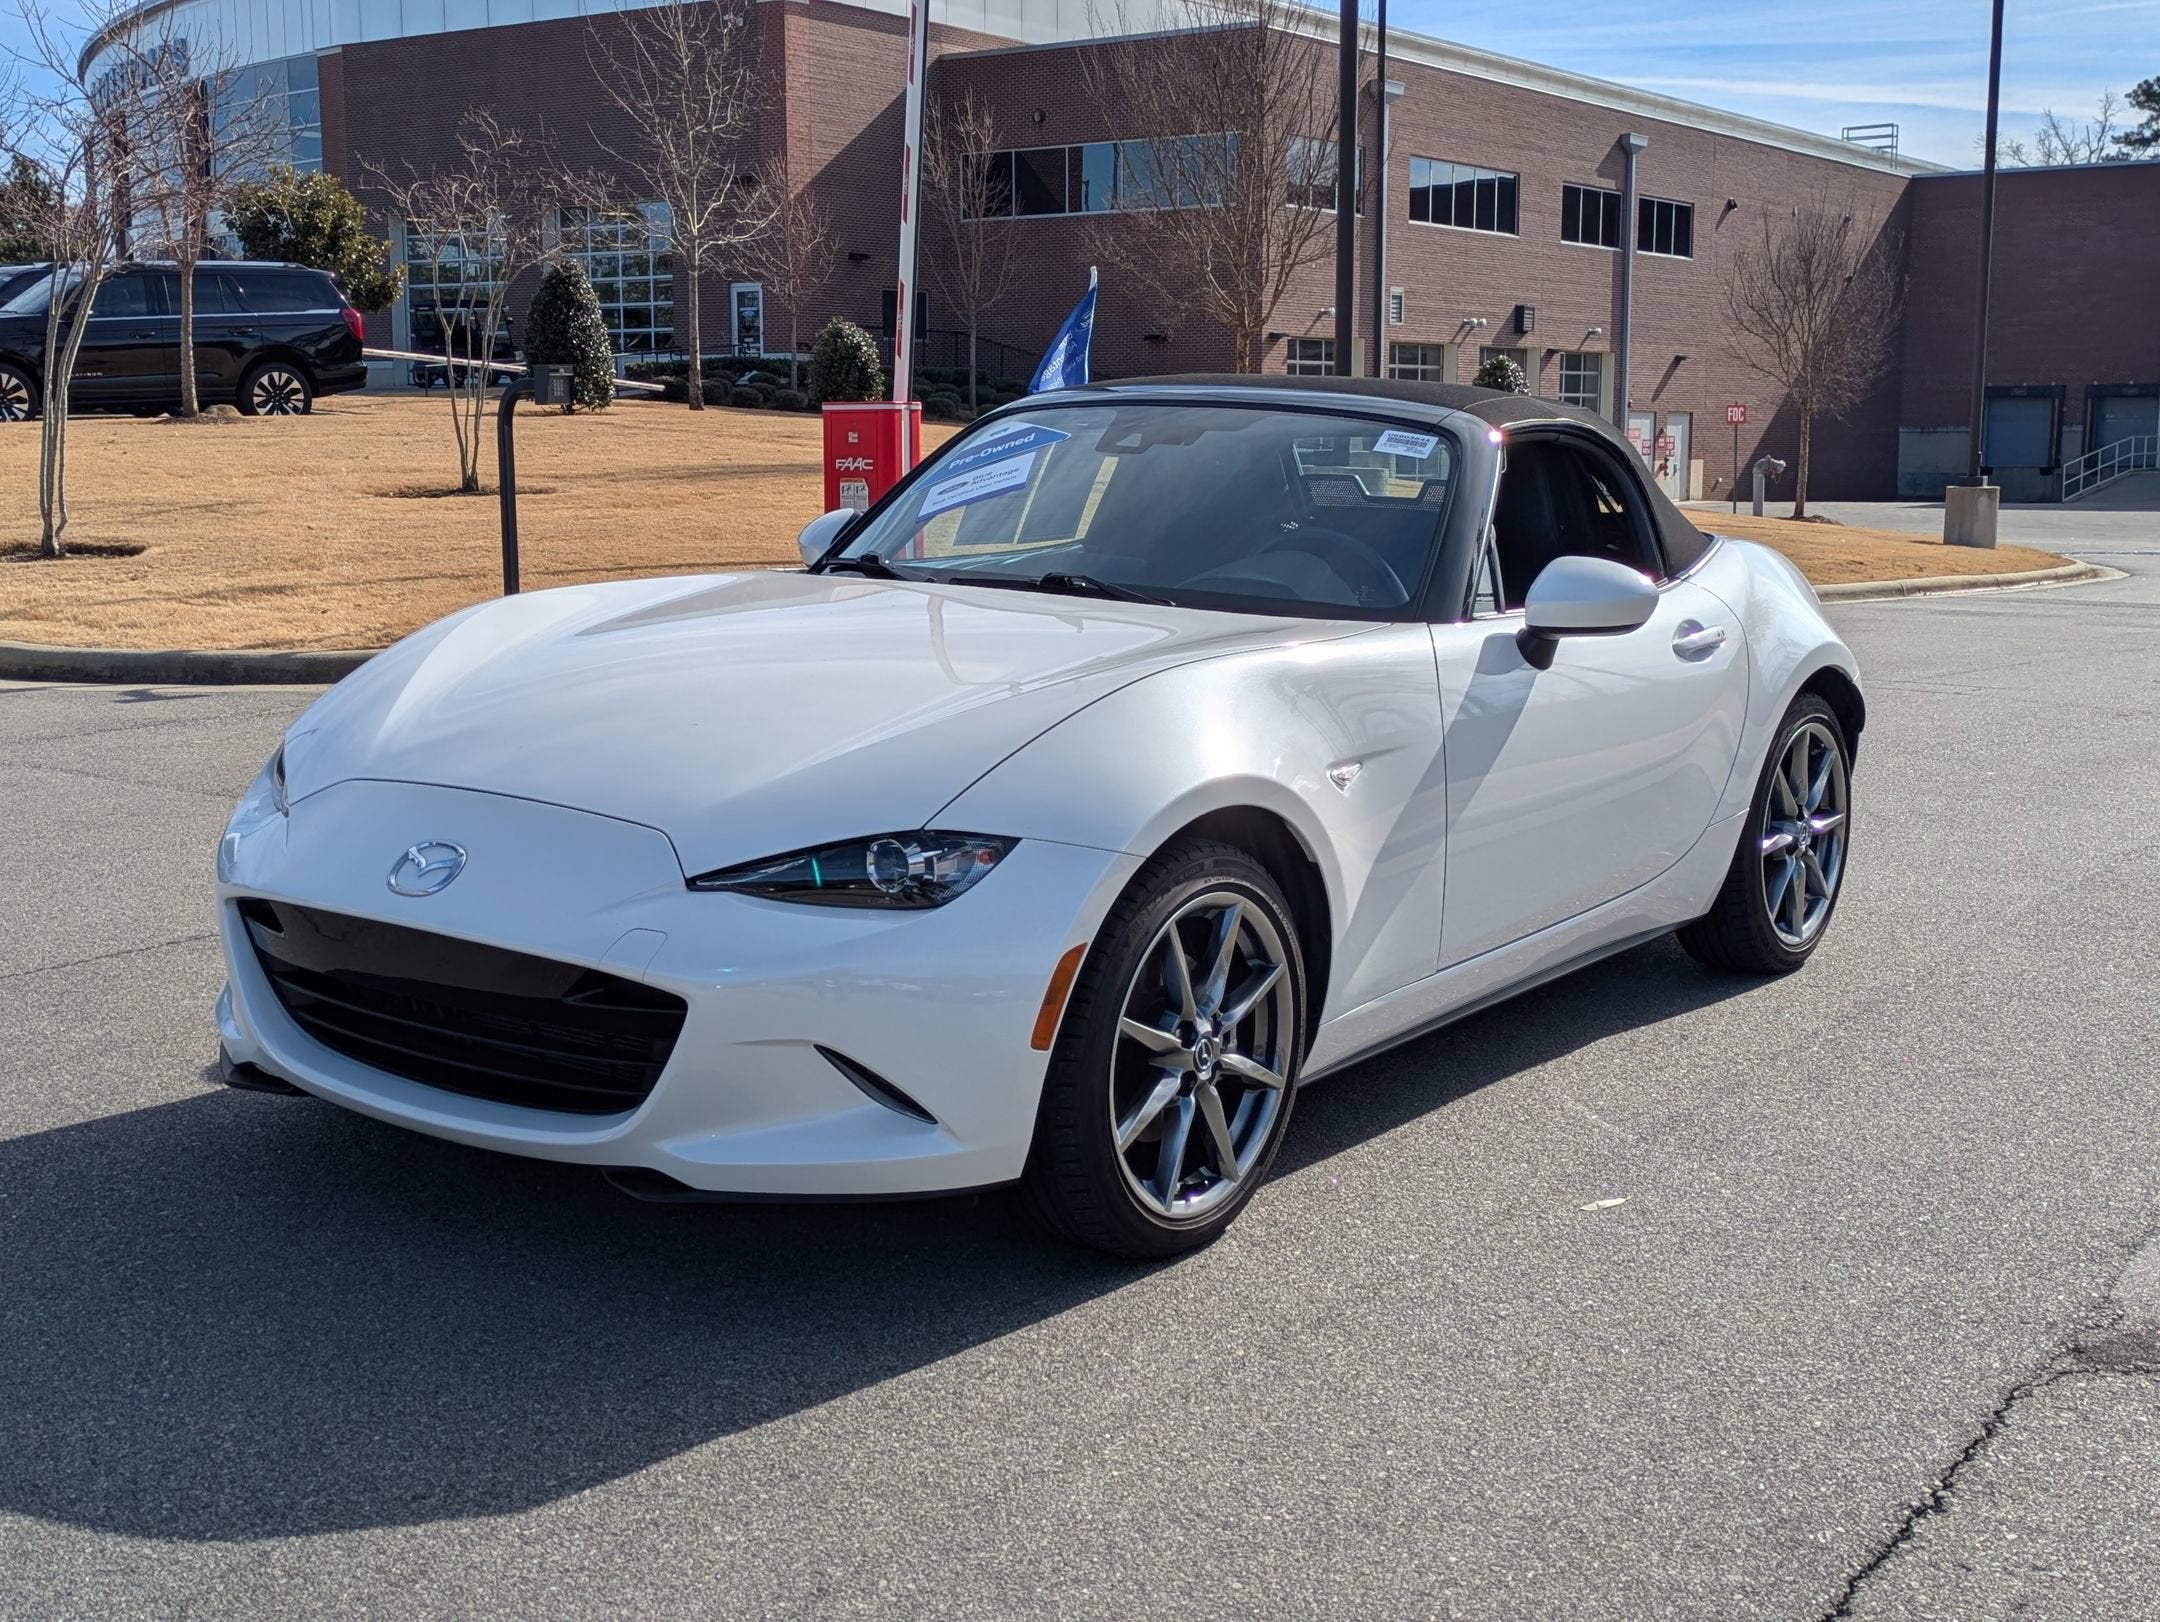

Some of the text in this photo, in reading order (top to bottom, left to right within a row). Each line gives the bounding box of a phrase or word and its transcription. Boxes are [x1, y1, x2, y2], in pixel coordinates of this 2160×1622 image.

[1728, 407, 1745, 422] FDC
[948, 433, 1036, 469] Pre-Owned
[835, 457, 874, 471] FAAC
[970, 469, 1020, 485] Advantage
